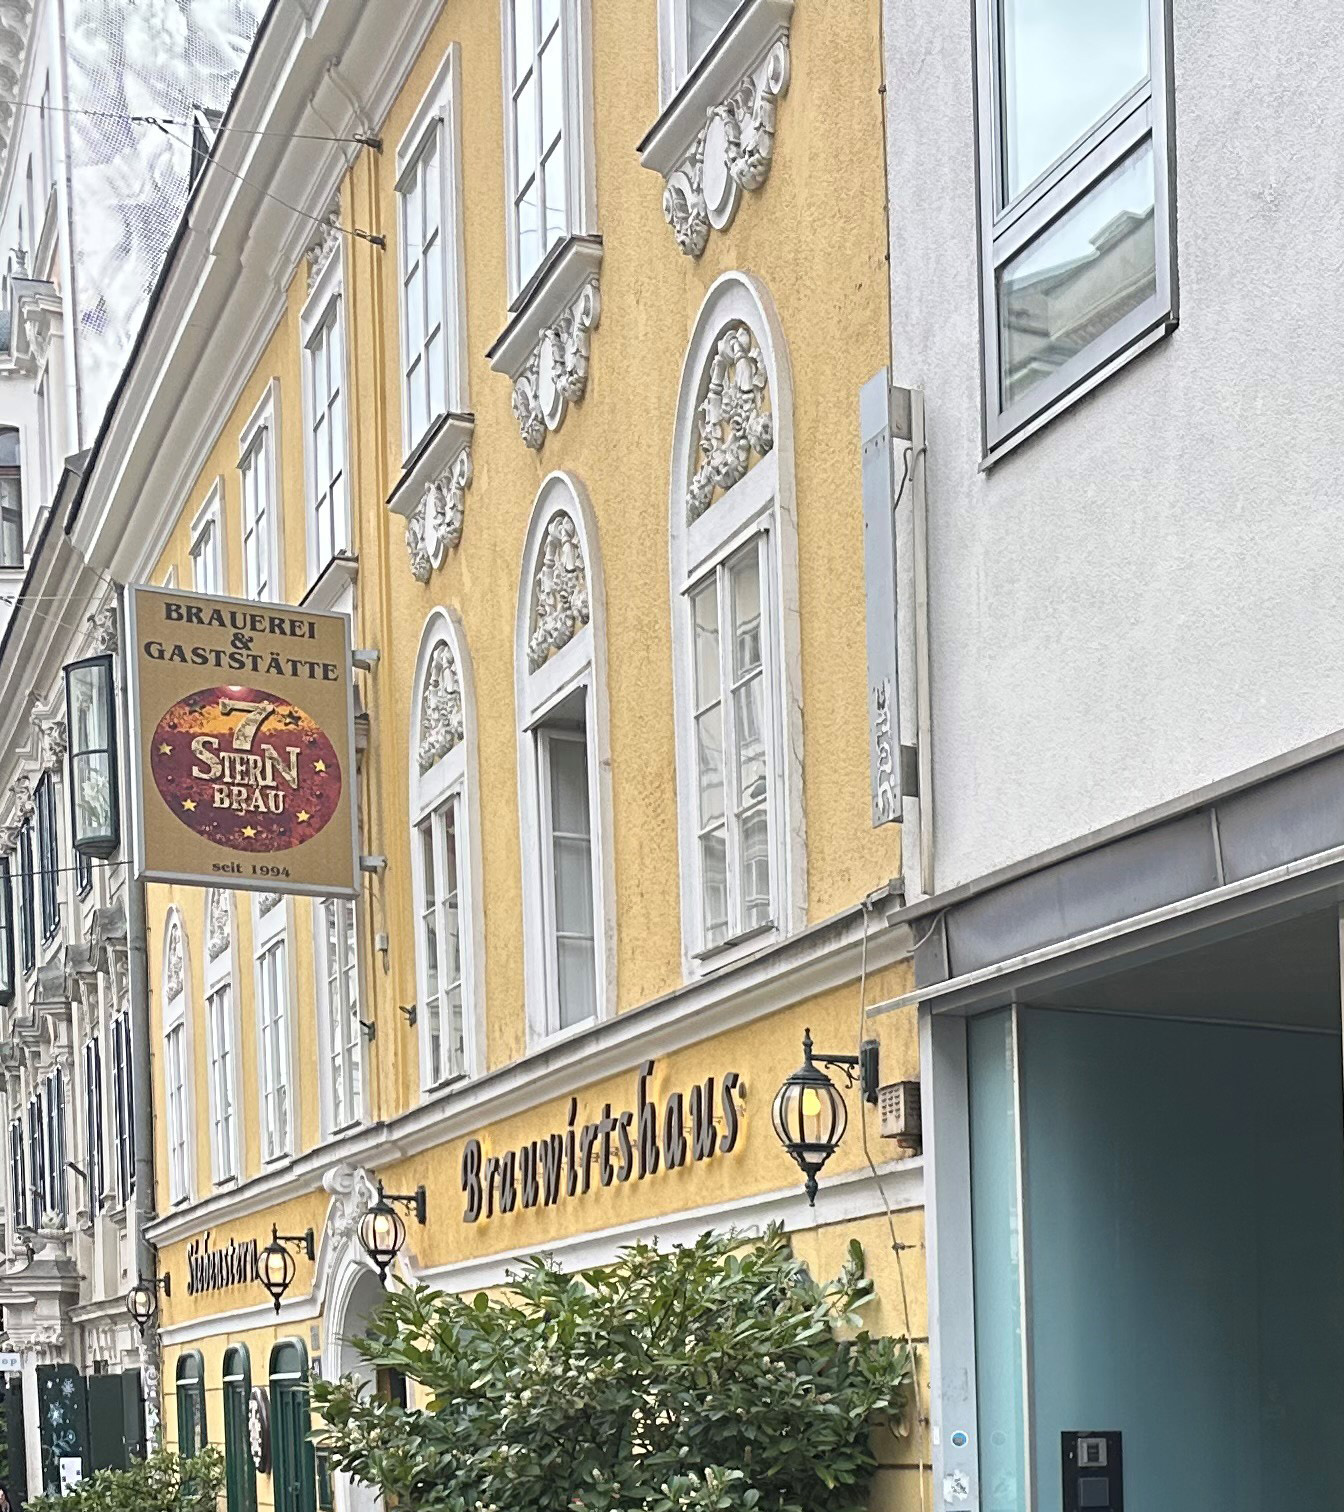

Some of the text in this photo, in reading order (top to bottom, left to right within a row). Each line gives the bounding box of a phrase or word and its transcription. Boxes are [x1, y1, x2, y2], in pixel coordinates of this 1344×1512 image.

[164, 601, 317, 640] BRAUEREI
[230, 632, 254, 651] &
[143, 640, 340, 682] GASTSTÄTTE
[218, 697, 275, 751] 7
[191, 735, 301, 790] STERN
[211, 861, 291, 878] seit 1994
[461, 1059, 740, 1223] Brauwirtshaus
